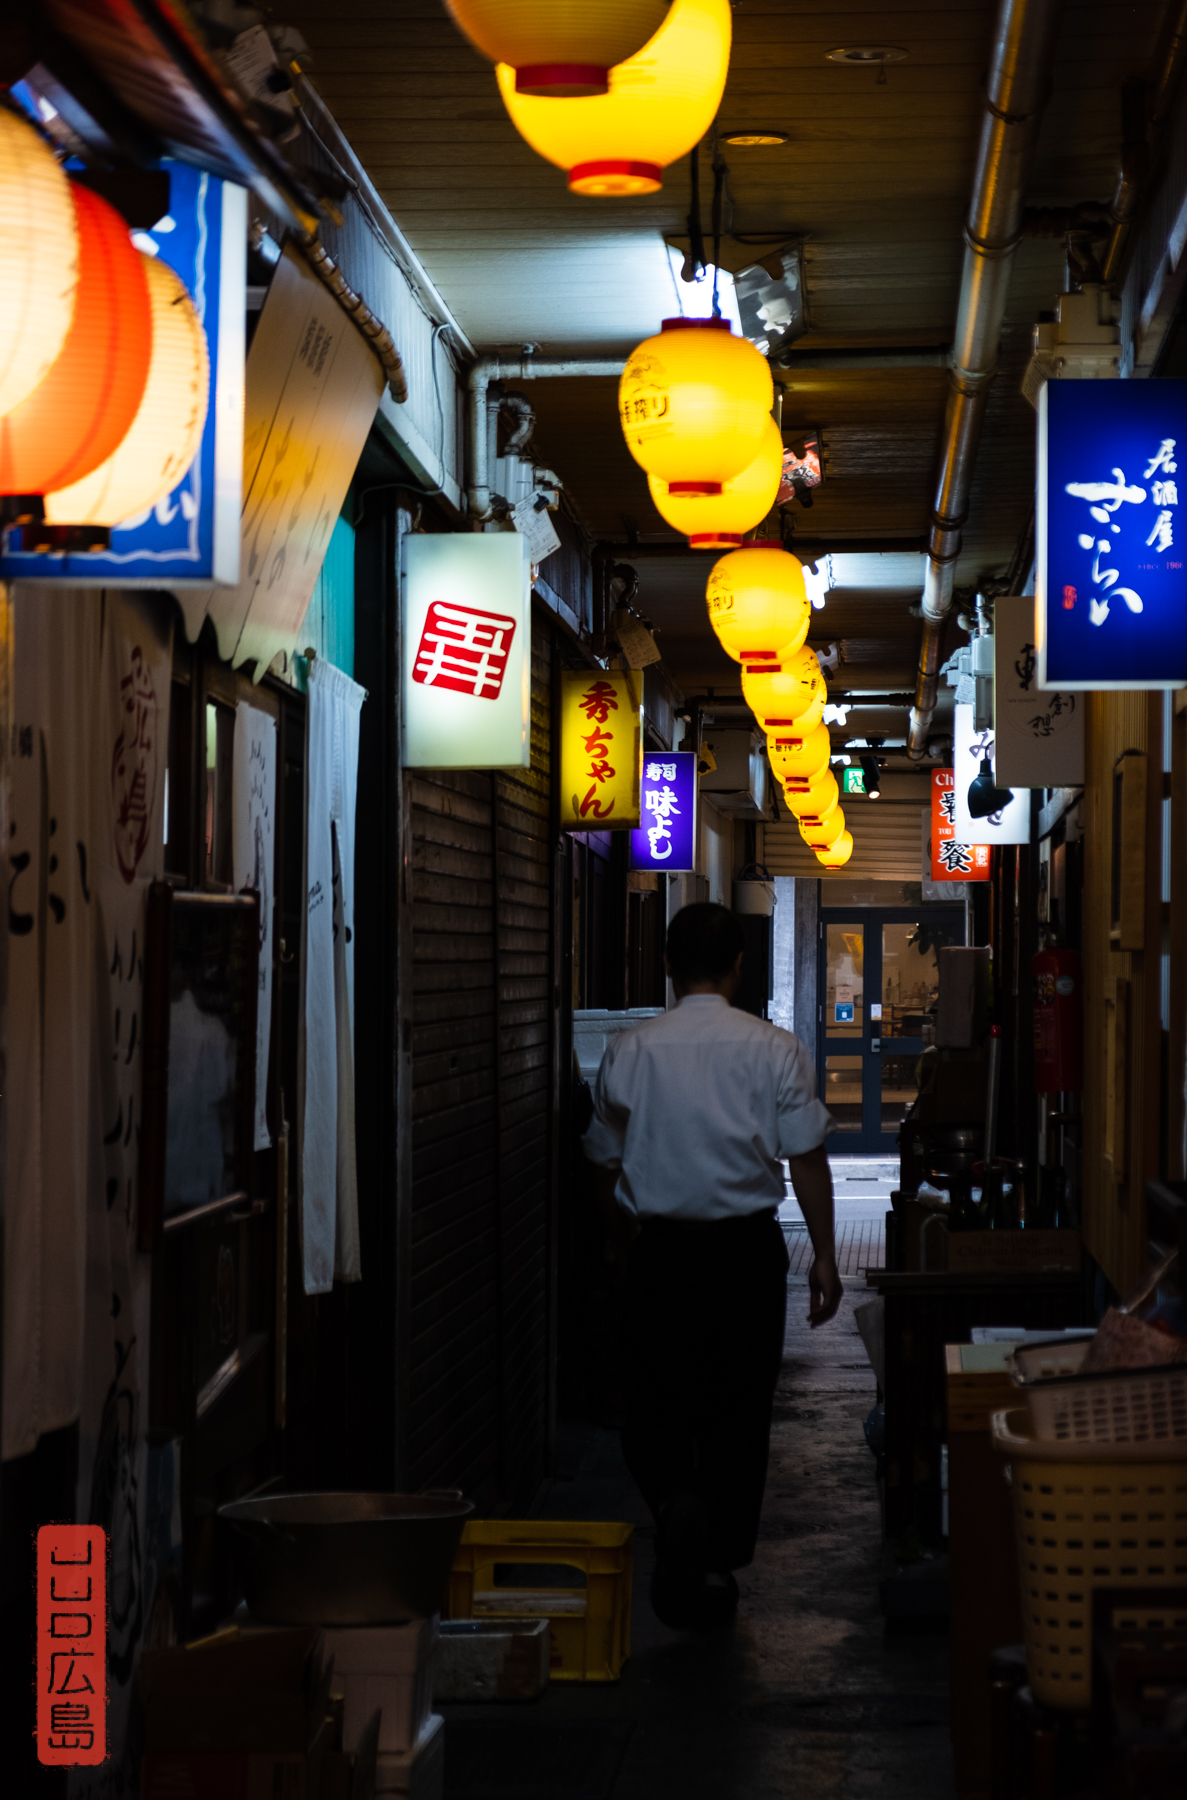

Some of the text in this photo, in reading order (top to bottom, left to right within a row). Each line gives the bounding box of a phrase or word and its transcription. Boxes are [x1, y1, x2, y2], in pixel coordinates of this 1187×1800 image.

[1143, 438, 1178, 552] 居酒屋
[578, 681, 619, 819] 秀ちゃん
[645, 763, 677, 782] 寿司
[645, 786, 681, 860] 味よし
